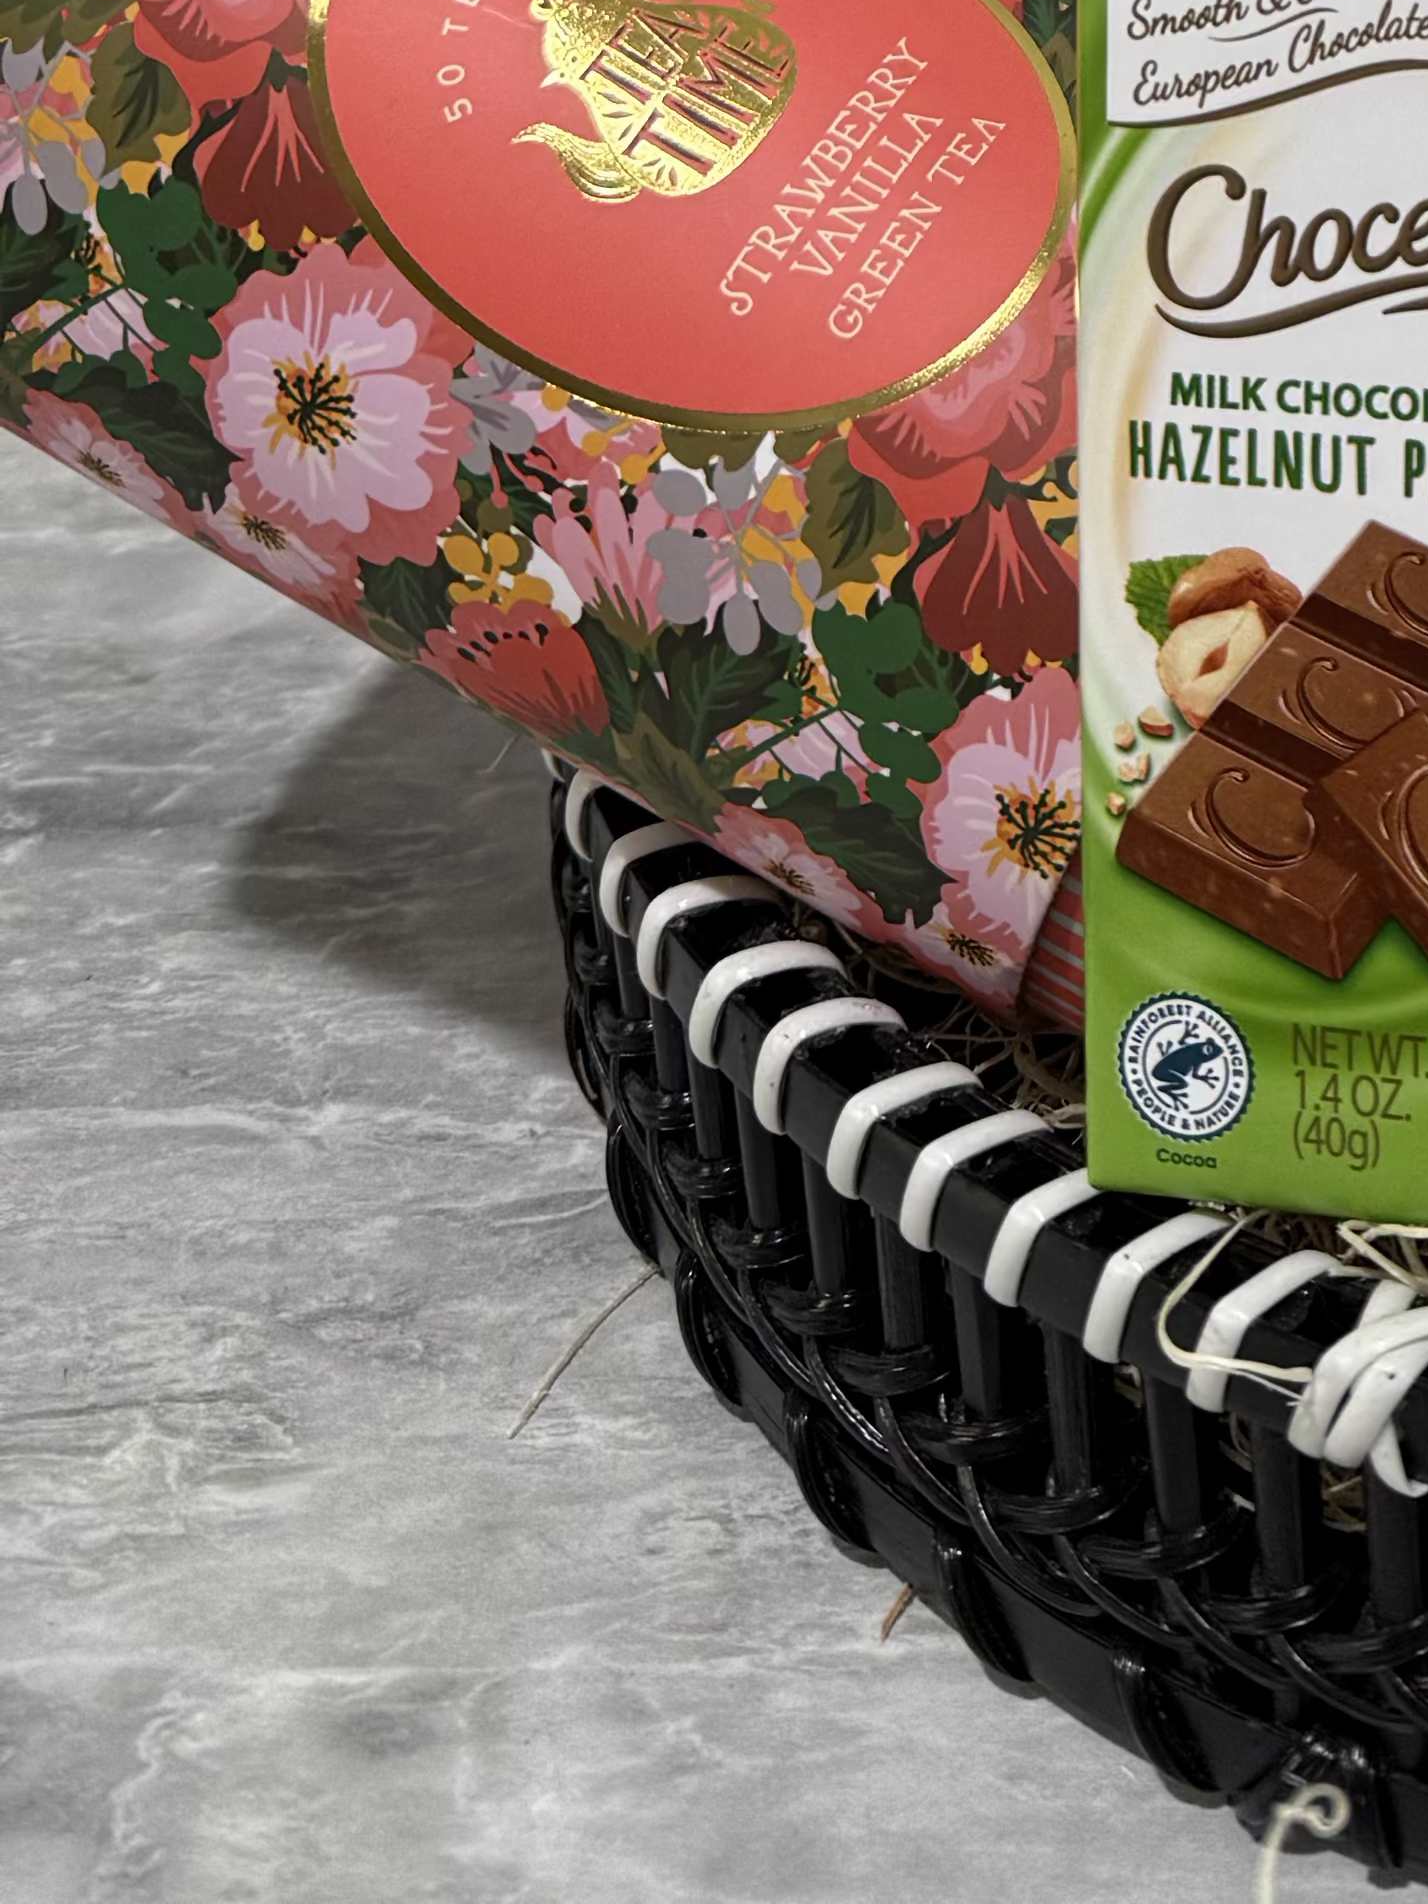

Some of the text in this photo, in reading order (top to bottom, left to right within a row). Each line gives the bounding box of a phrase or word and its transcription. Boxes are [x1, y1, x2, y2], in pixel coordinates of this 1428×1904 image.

[579, 7, 710, 106] TEA
[1132, 54, 1280, 110] European
[436, 61, 474, 123] 50
[621, 18, 791, 178] TIME
[720, 36, 931, 318] STRAWBERRY
[789, 108, 944, 281] VANILLA
[827, 113, 1007, 341] GREEN TEA
[1169, 371, 1267, 413] MILK
[1128, 418, 1377, 497] HAZELNUT
[1128, 1003, 1245, 1079] RAINFOREST ALLIANCE
[1292, 1023, 1362, 1071] NET
[1131, 1078, 1177, 1127] PEOPLE
[1194, 1091, 1242, 1131] NATURE
[1294, 1069, 1412, 1122] 1.4 OZ.
[1156, 1148, 1217, 1169] Cocoa
[1293, 1110, 1380, 1172] (40g)
